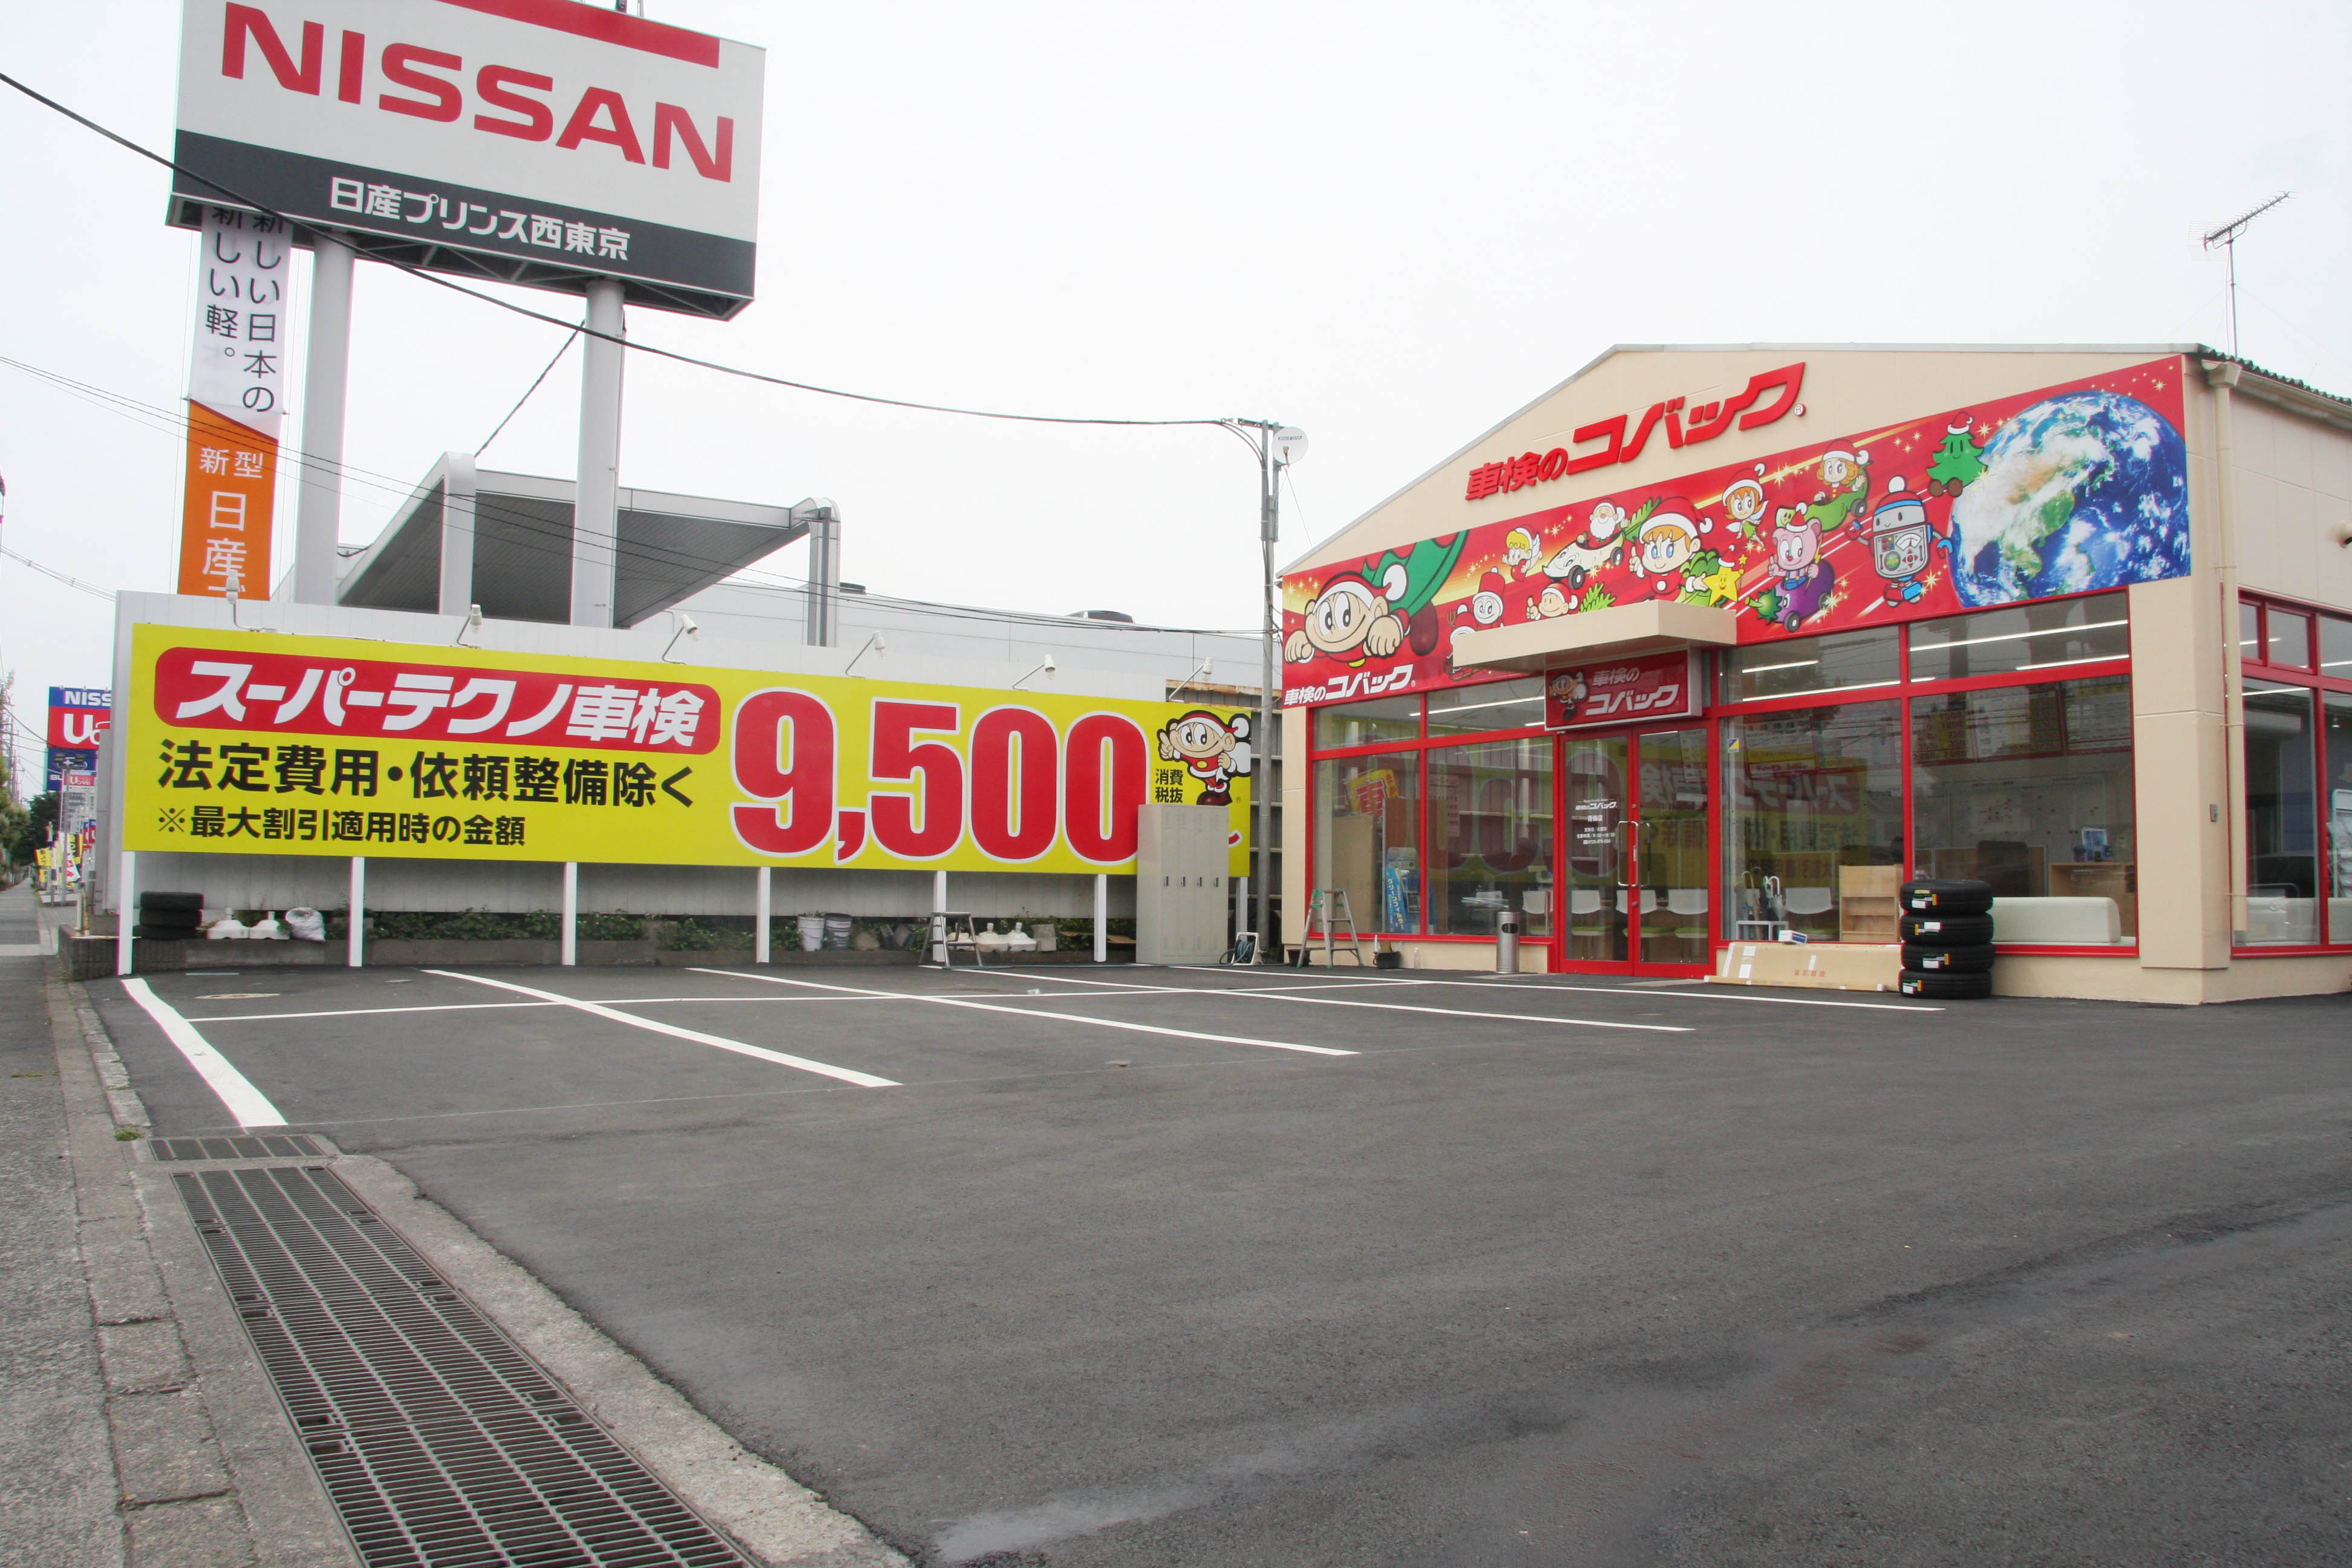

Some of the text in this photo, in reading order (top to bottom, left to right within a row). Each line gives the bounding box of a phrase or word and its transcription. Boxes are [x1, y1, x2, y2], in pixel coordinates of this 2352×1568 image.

[221, 1, 734, 183] NISSAN
[329, 176, 630, 261] 日産プリンス西東京
[1465, 361, 1806, 501] 車検のコバック
[200, 446, 264, 479] 新型
[1284, 664, 1414, 705] 車検のコバック
[1592, 667, 1639, 687] 車検の
[175, 660, 705, 748] スーパーテクノ車検
[1585, 684, 1679, 716] コバック
[155, 738, 695, 809] 法定費用・依頼整備除く
[730, 687, 1148, 866] 9,500
[1155, 769, 1183, 785] 消費
[1155, 786, 1183, 803] 税抜
[158, 805, 525, 846] ※最大割引適用時の金額
